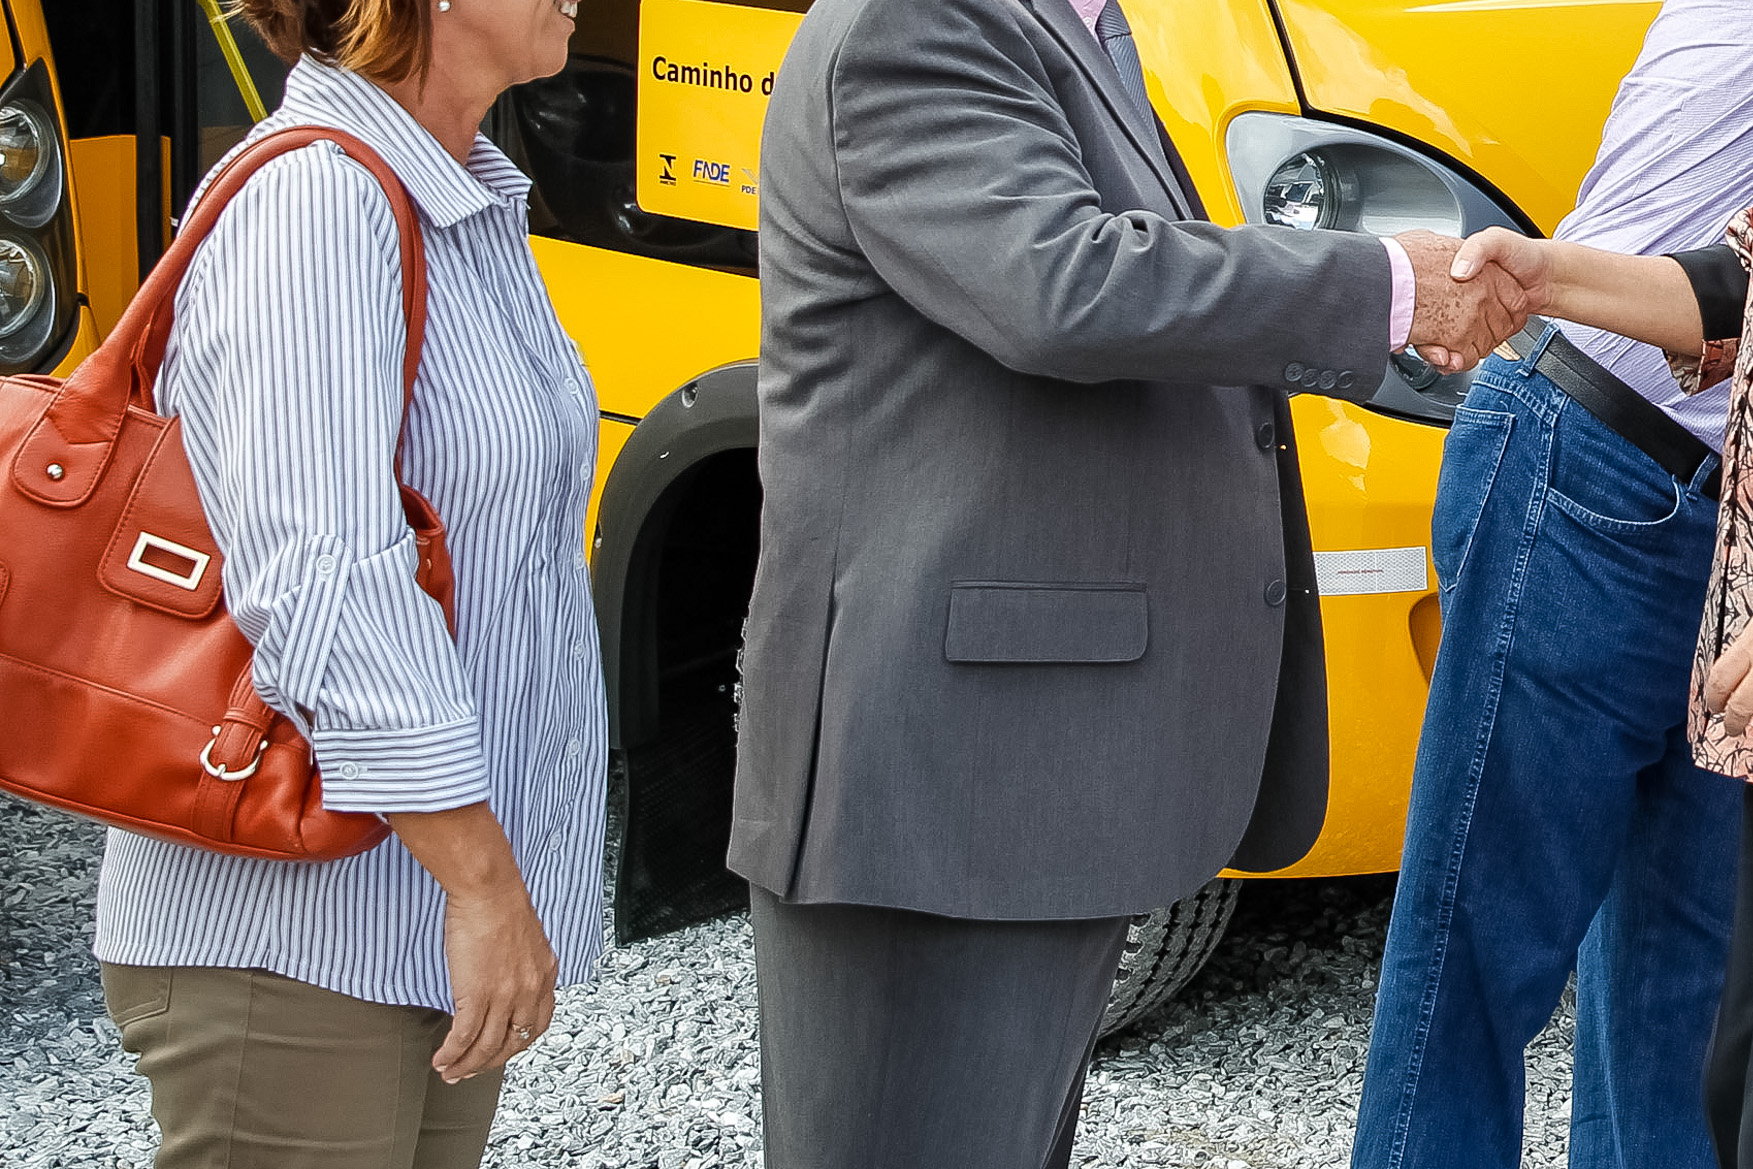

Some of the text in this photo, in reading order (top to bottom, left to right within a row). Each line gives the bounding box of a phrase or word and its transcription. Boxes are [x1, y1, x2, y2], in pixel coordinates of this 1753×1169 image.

[652, 55, 775, 96] Caminho d
[693, 159, 731, 183] FNDE
